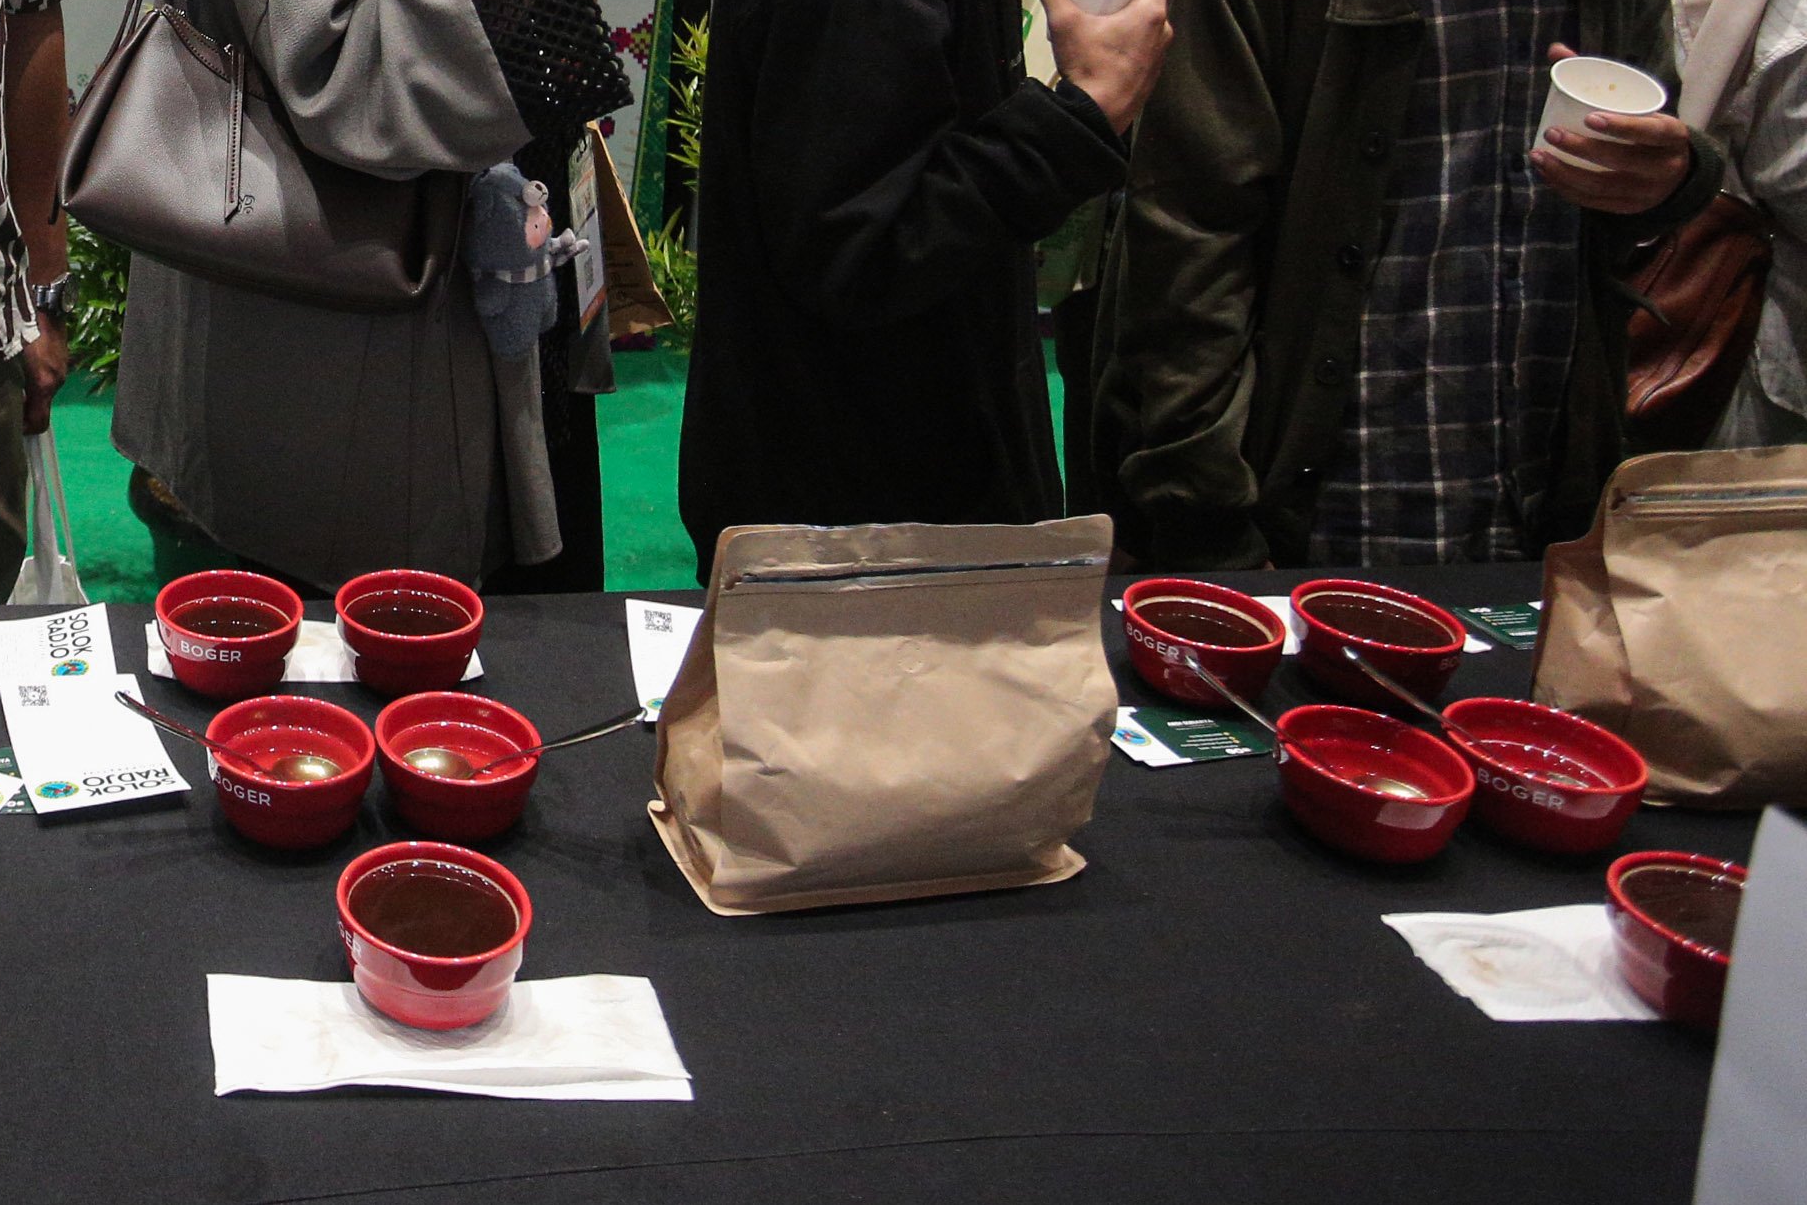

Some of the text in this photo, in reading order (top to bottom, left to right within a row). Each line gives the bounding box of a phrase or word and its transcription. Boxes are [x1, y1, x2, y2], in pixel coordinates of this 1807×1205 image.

[47, 617, 70, 659] RADJO
[69, 612, 93, 657] SOLOK
[181, 640, 242, 662] BOGER
[1126, 621, 1180, 660] BOGER
[82, 768, 170, 787] RADJO
[86, 778, 176, 797] SOLOK
[214, 770, 272, 808] BOGER
[1477, 767, 1565, 810] BOGER
